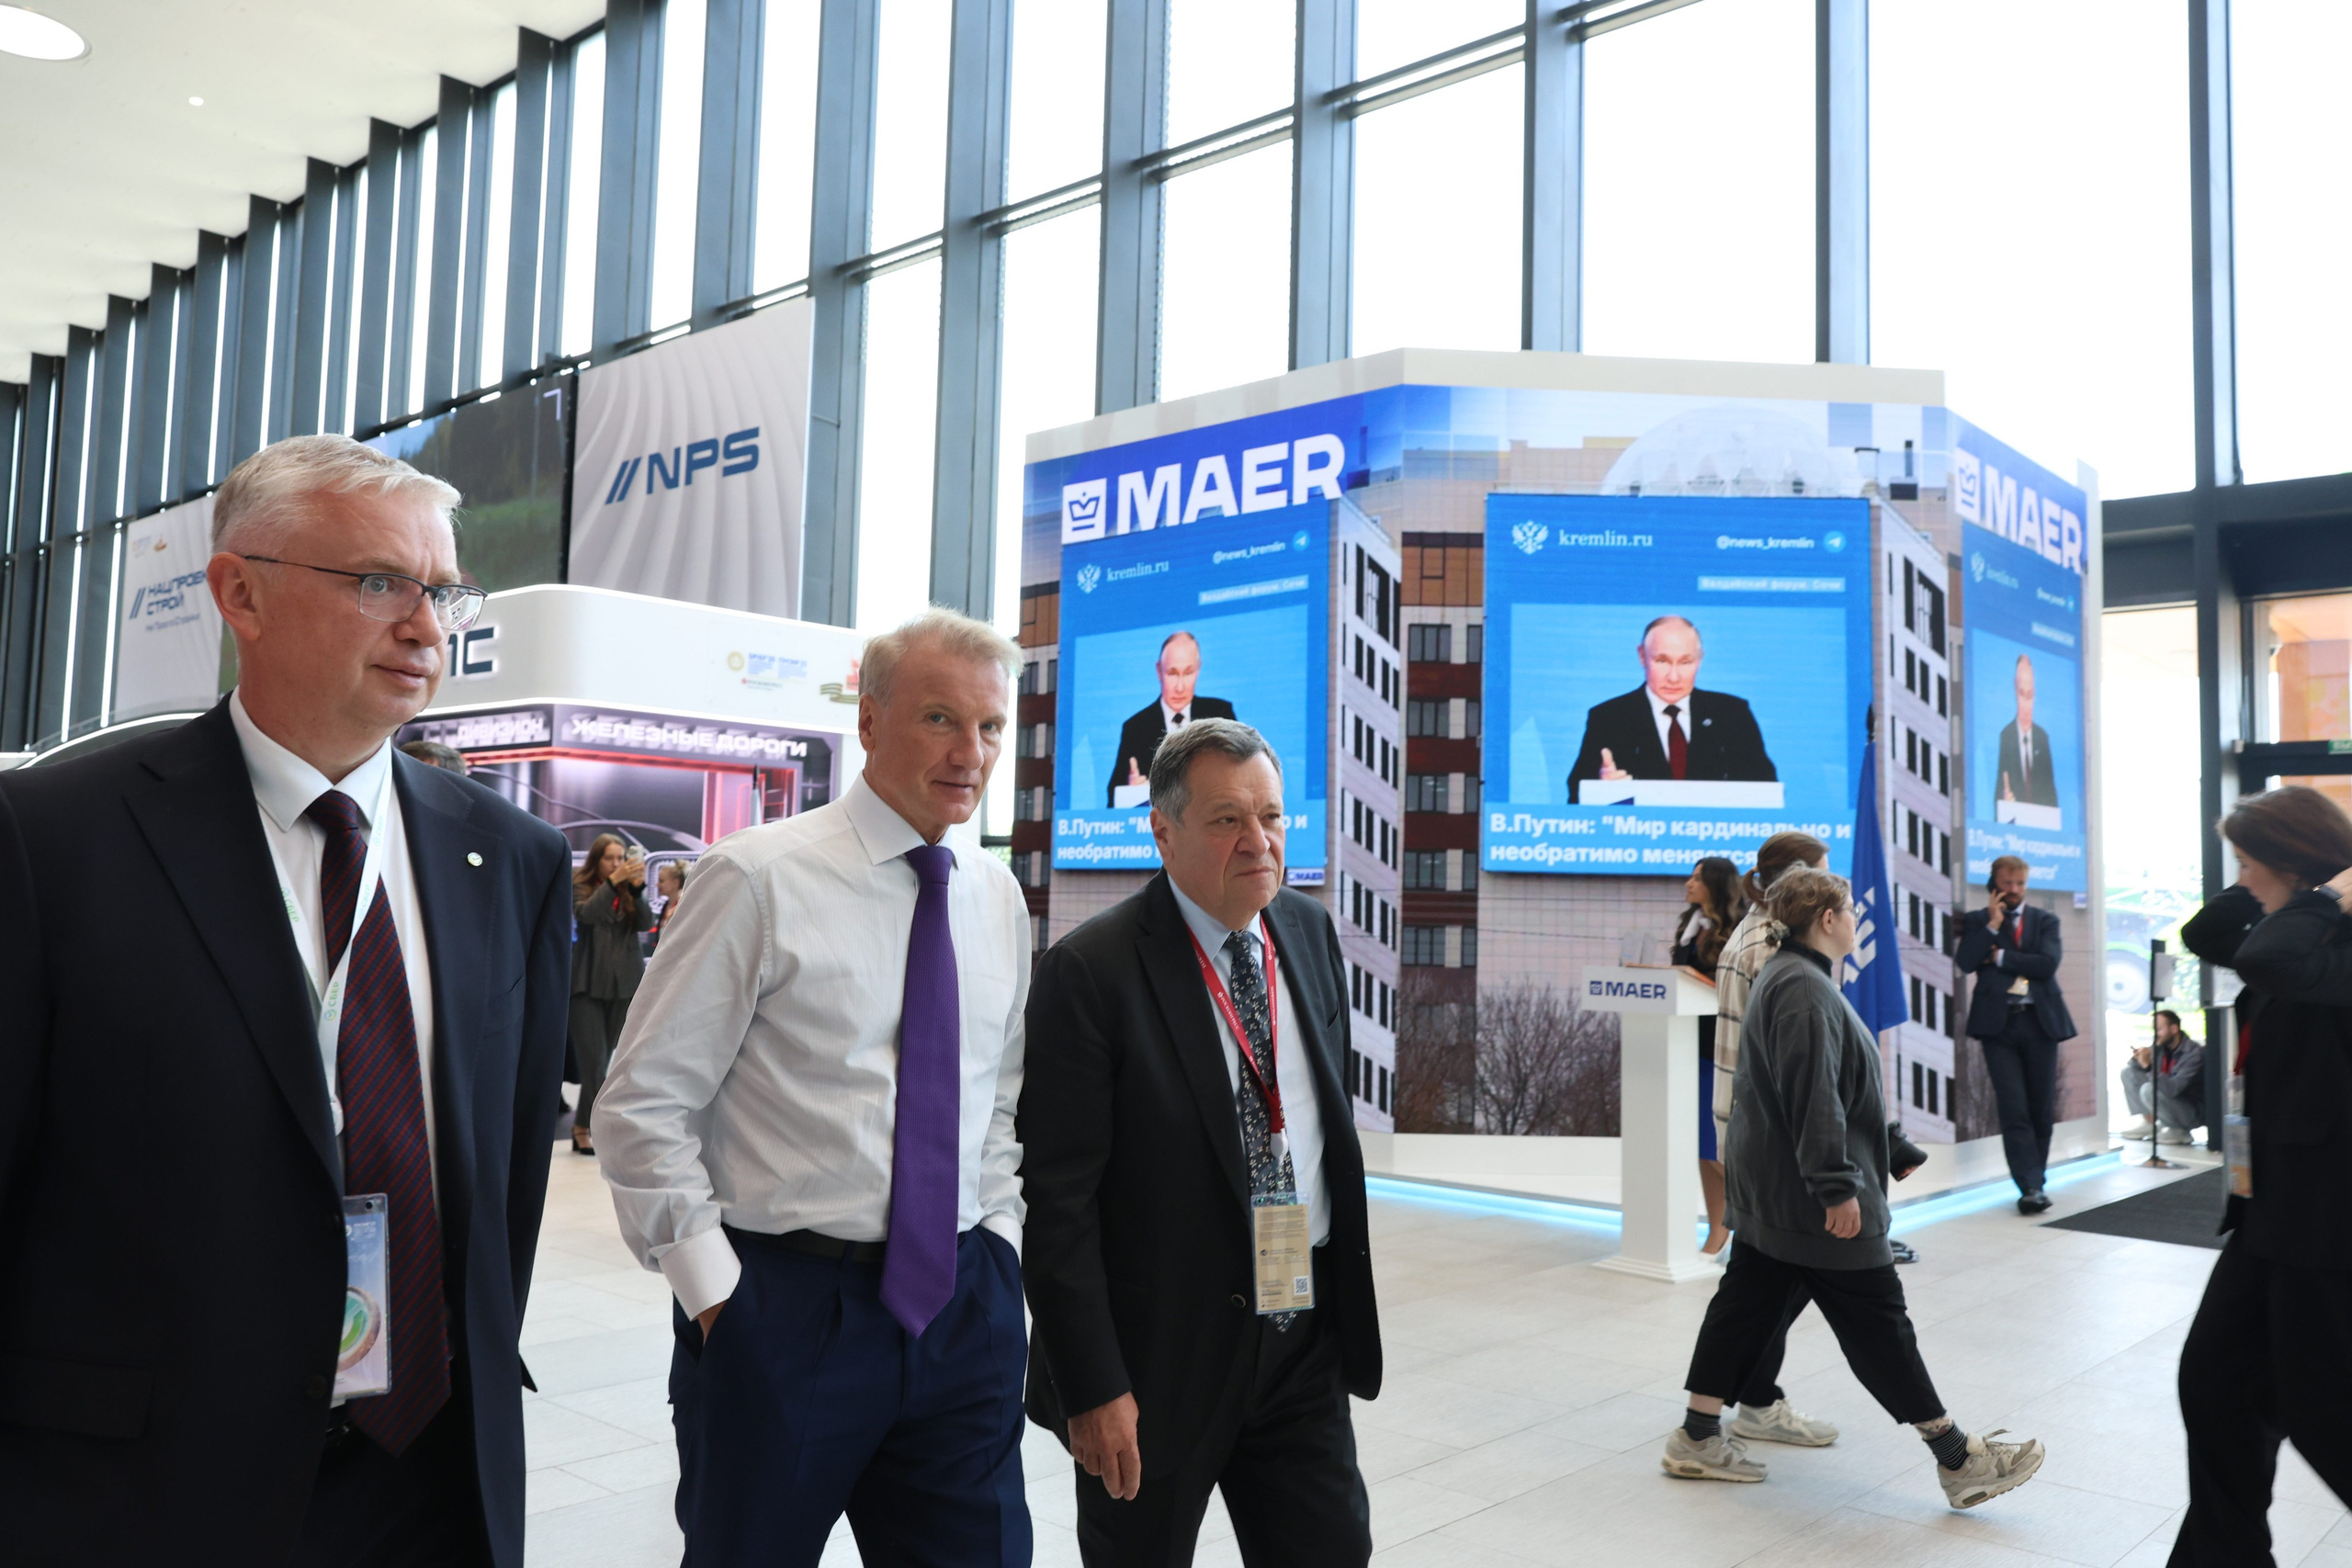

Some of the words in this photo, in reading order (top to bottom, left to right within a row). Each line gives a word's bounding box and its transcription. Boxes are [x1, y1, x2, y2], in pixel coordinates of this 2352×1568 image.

[1116, 433, 1345, 536] MAER
[1984, 464, 2082, 575] MAER
[1559, 529, 1653, 547] kremlin.ru
[1715, 535, 1815, 550] @news_kremlin
[1213, 540, 1286, 564] @news_kremlin
[1106, 560, 1169, 582] kremlin.ru
[147, 591, 184, 615] СТРОЙ
[571, 719, 715, 749] ЖЕЛЕЗНЫЕ
[716, 734, 807, 757] ДОРОГИ
[1057, 818, 1125, 839] В.Путин:
[1490, 813, 1596, 838] В.Путин:
[1601, 815, 1667, 840] "Мир
[1670, 820, 1831, 841] кардинально
[1835, 823, 1851, 839] и
[1057, 842, 1153, 863] необратимо
[1489, 842, 1638, 866] необратимо
[328, 981, 339, 1008] СБЕР
[1605, 981, 1667, 999] MAER
